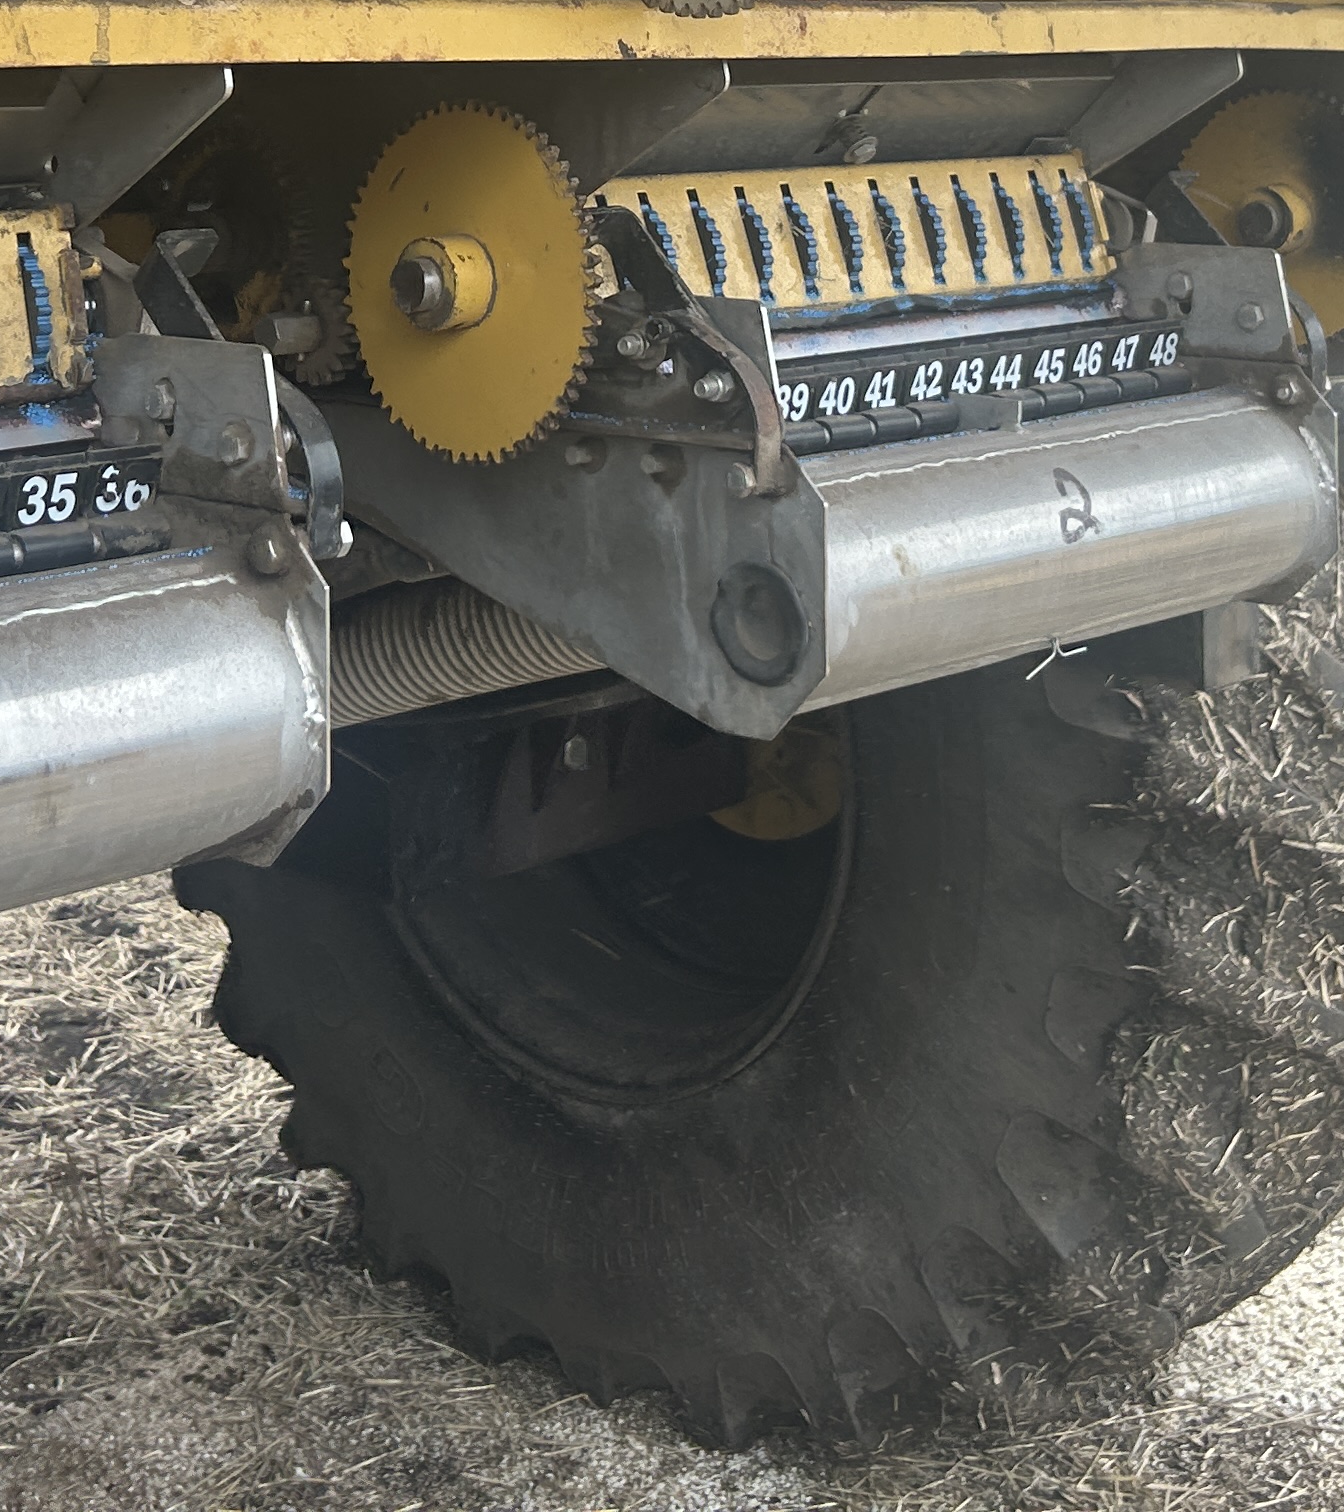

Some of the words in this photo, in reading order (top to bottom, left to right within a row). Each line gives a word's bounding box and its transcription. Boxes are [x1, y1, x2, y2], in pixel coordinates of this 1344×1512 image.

[777, 382, 810, 422] 39
[818, 376, 855, 416] 40
[864, 369, 896, 409] 41
[910, 360, 943, 401] 42
[950, 357, 984, 395] 43
[989, 353, 1022, 391] 44
[1033, 348, 1066, 385] 45
[1072, 341, 1104, 378] 46
[1111, 334, 1140, 372] 47
[1148, 332, 1179, 367] 48
[17, 472, 78, 525] 35
[95, 465, 150, 512] 36
